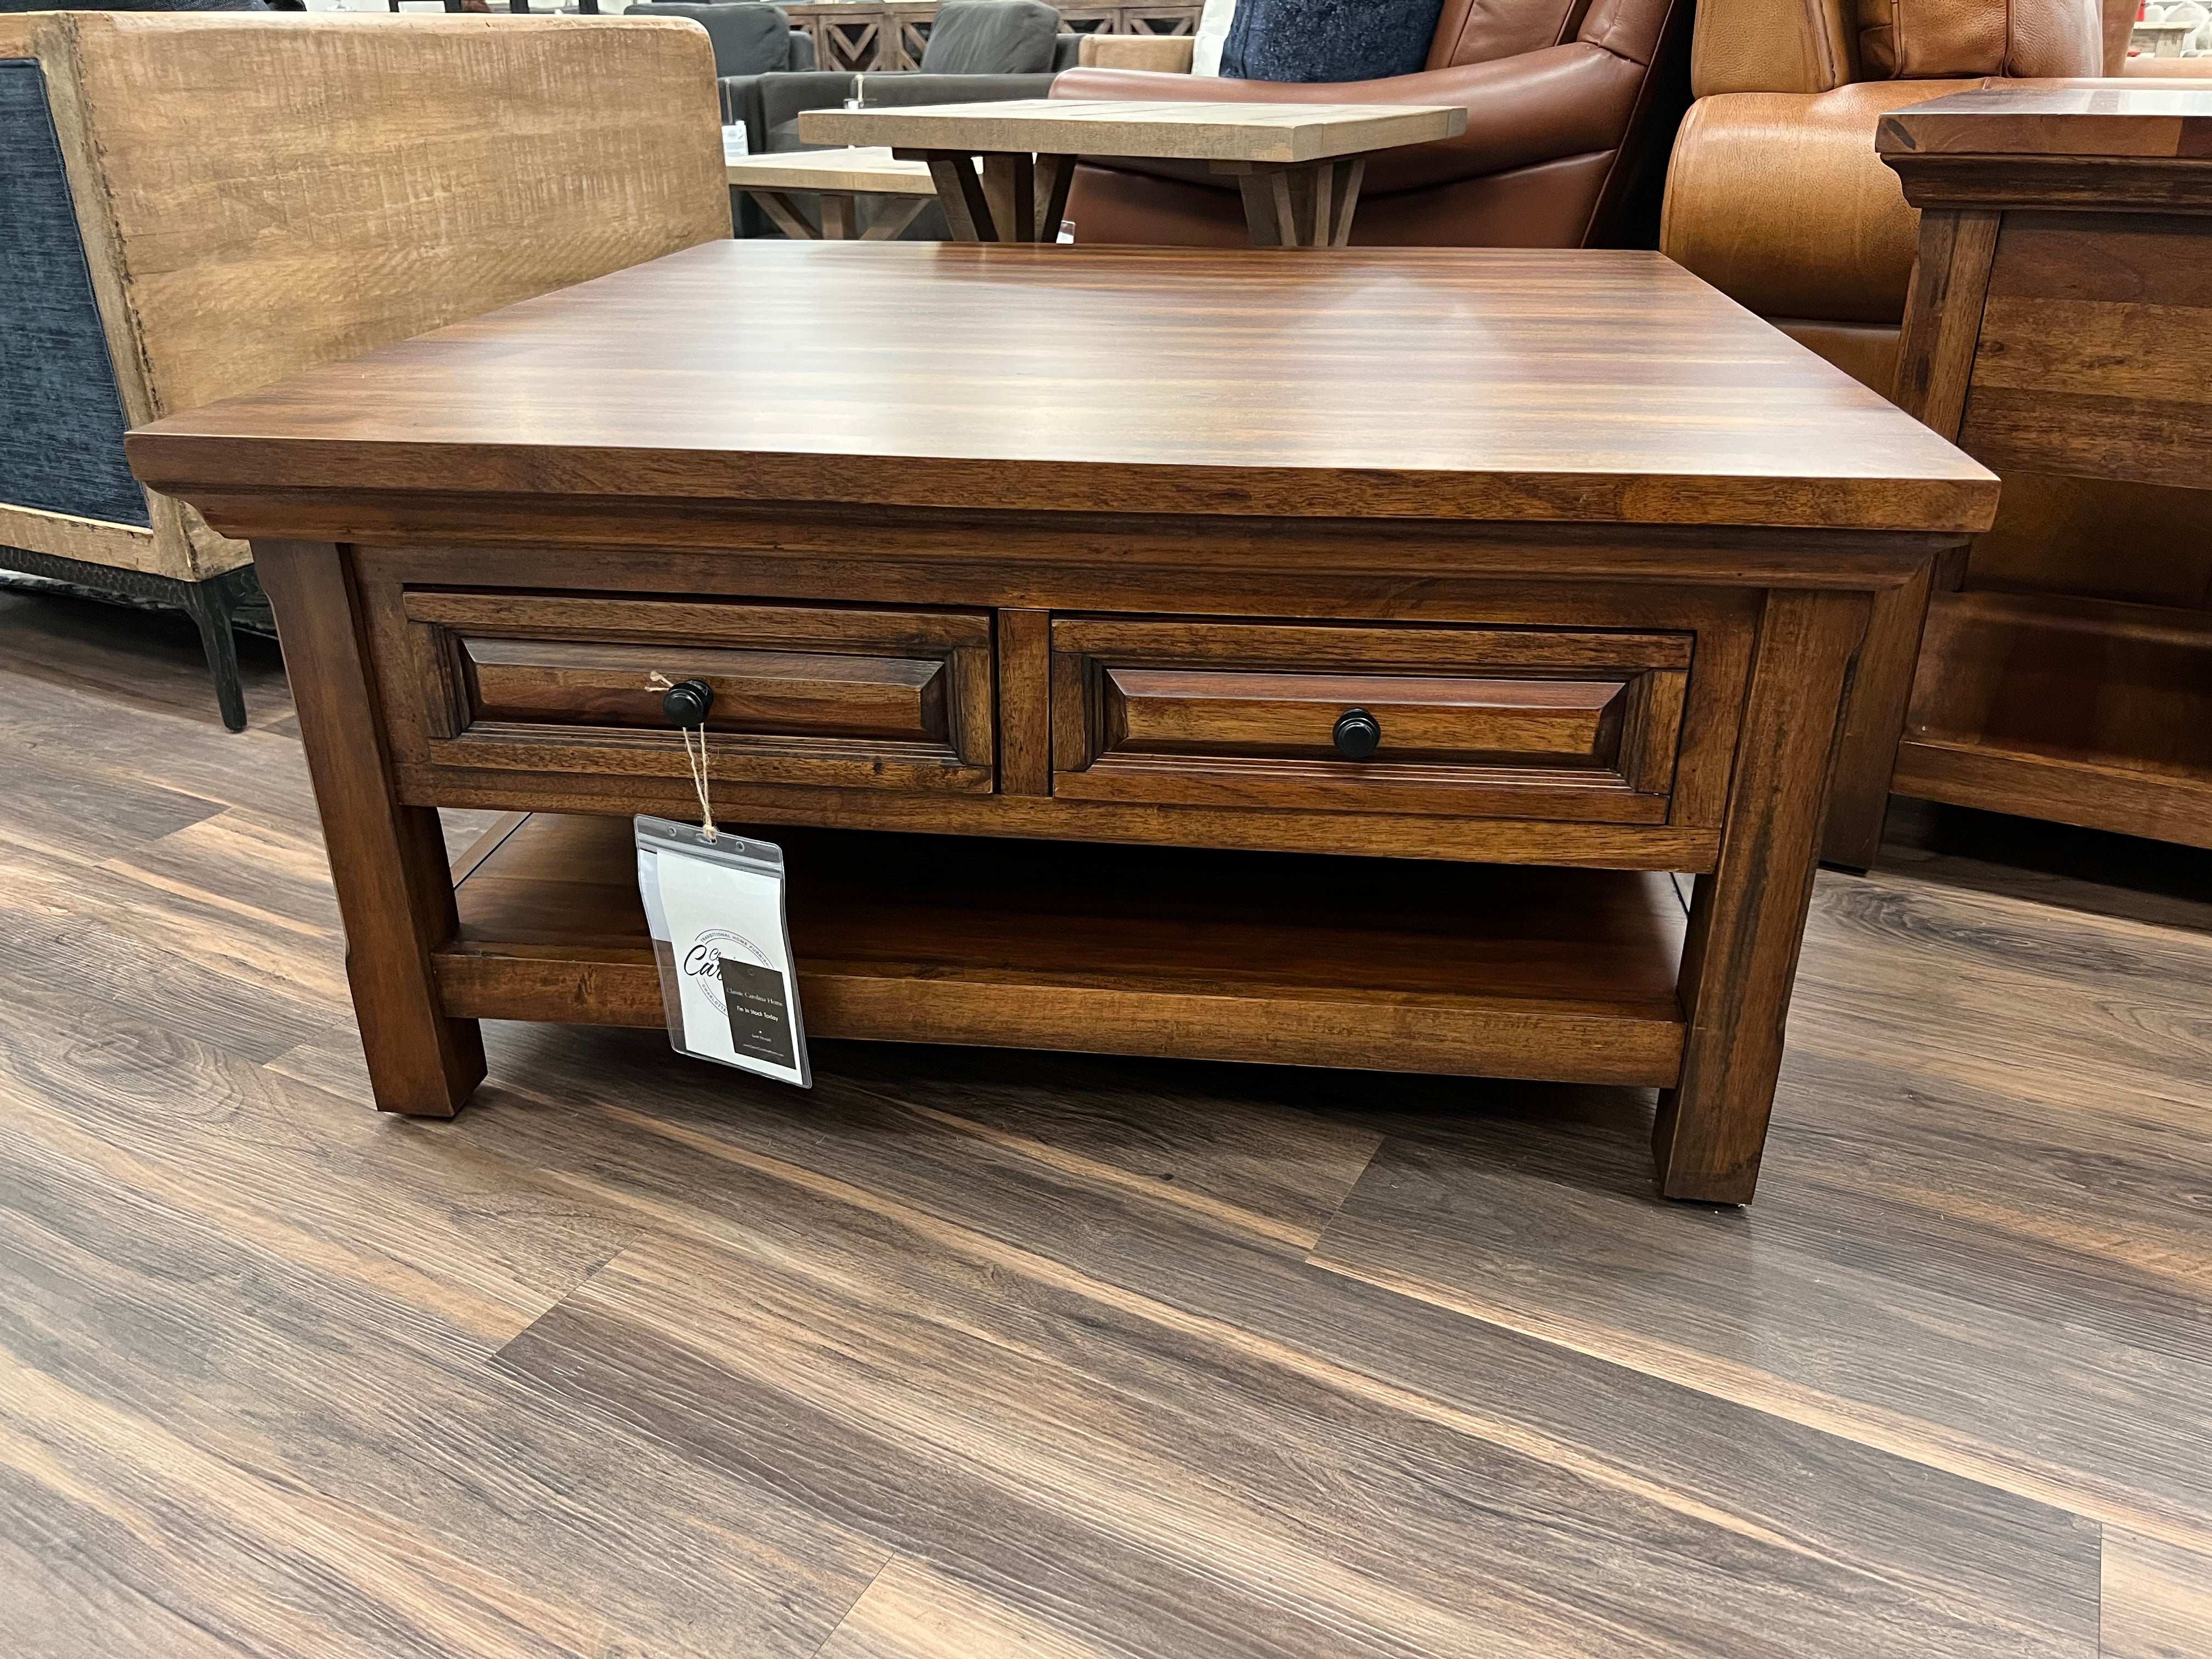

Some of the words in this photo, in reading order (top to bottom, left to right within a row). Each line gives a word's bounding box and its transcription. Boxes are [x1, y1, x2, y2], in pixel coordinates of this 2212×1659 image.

[700, 932, 729, 942] TRANSITIONAL
[732, 935, 747, 945] HOME
[726, 988, 744, 996] Classic
[744, 992, 766, 1002] Carolina
[767, 997, 783, 1007] Home
[764, 1012, 778, 1022] Today
